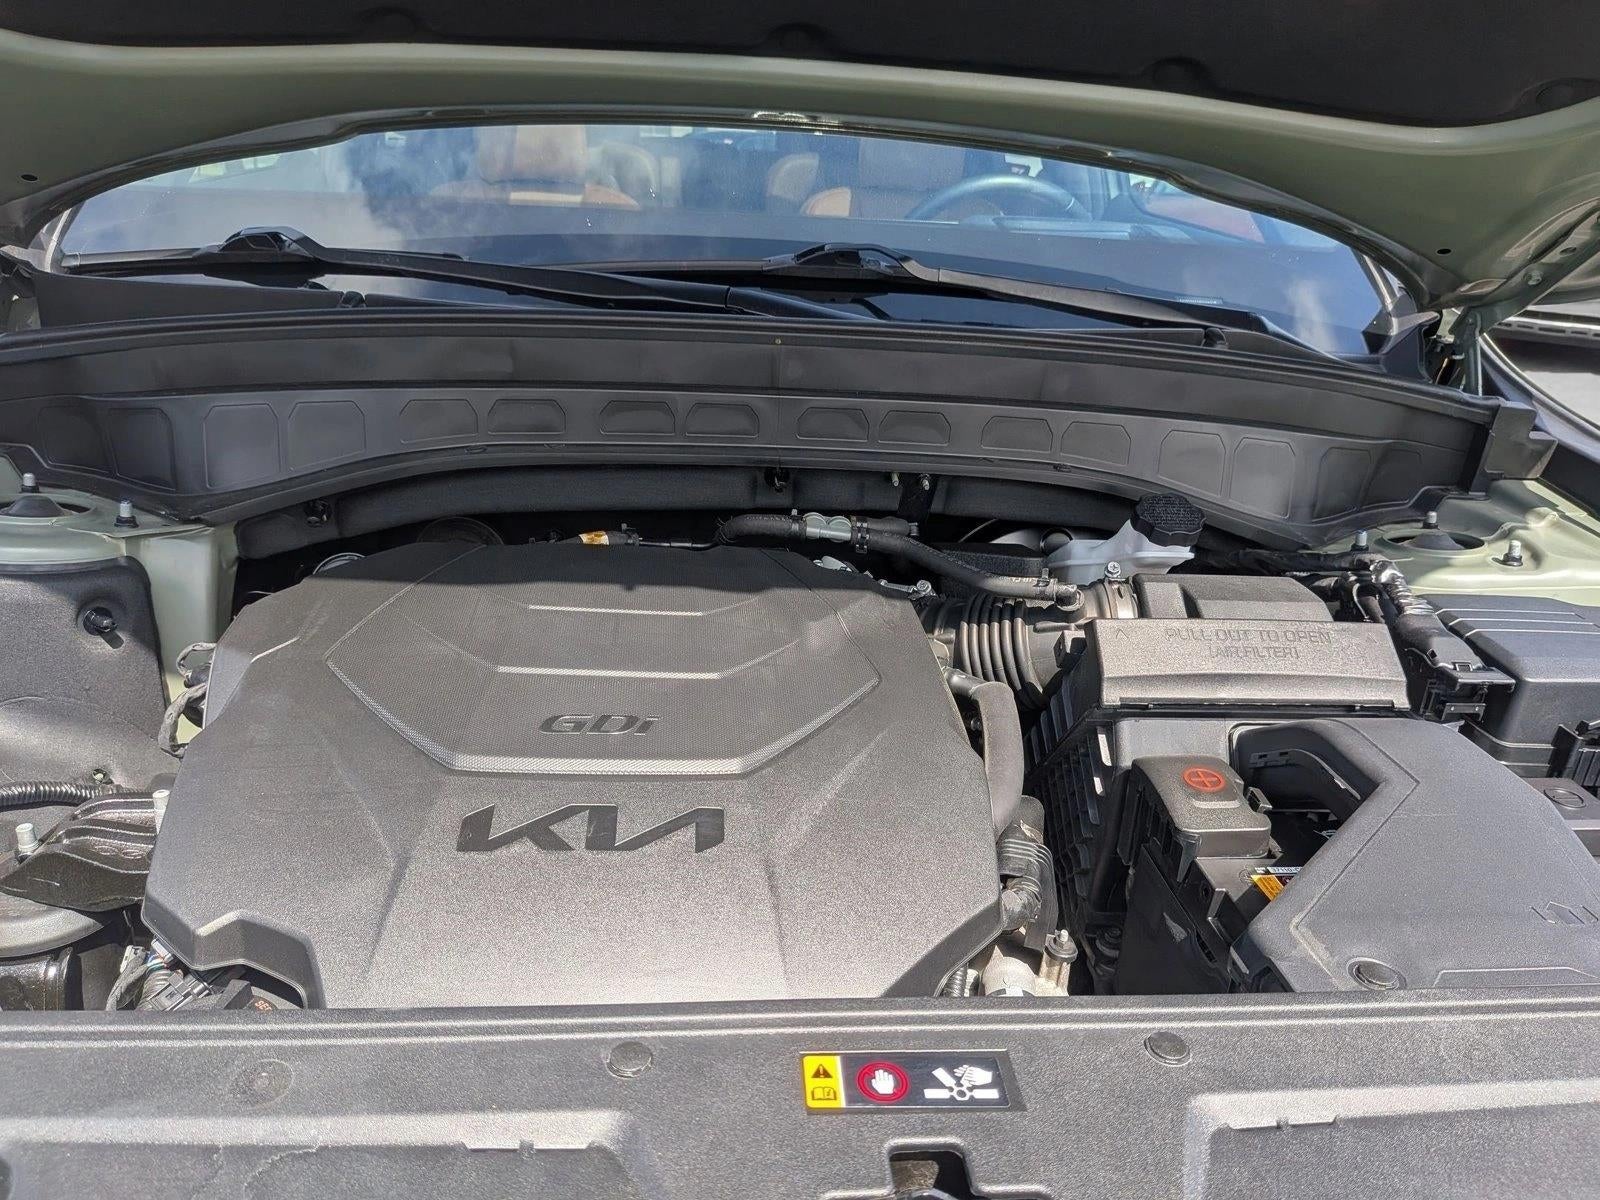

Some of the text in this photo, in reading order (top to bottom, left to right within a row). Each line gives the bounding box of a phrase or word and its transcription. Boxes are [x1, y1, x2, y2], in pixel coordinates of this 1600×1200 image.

[1165, 628, 1332, 644] PULL OUT TO OPEN
[538, 714, 661, 735] GDi
[456, 803, 725, 853] KIA
